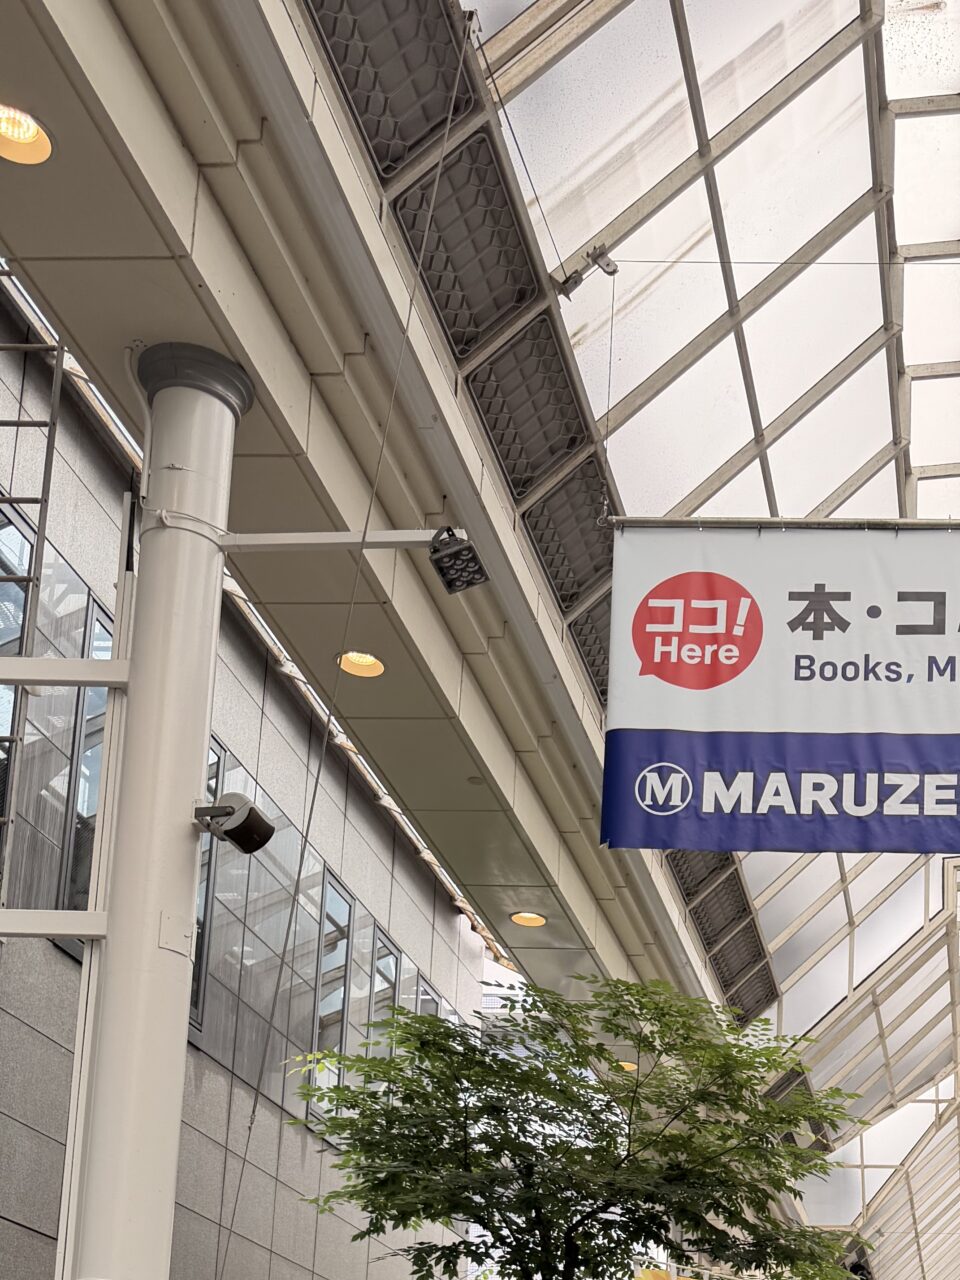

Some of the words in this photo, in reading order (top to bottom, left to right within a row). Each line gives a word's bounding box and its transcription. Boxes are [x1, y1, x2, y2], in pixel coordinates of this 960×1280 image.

[645, 596, 752, 636] ココ!
[654, 637, 739, 664] Here
[795, 654, 913, 683] Books,
